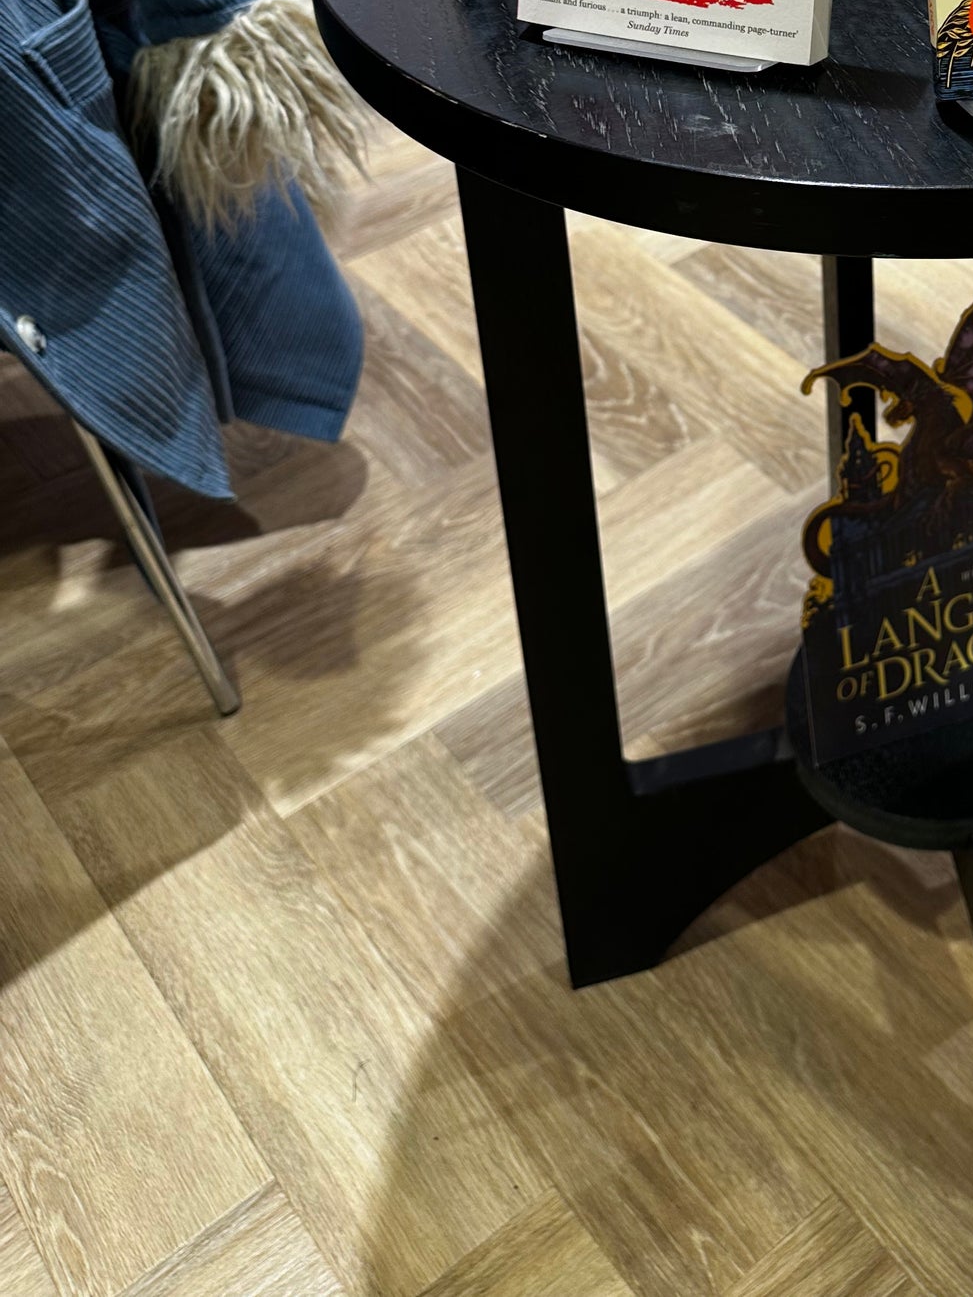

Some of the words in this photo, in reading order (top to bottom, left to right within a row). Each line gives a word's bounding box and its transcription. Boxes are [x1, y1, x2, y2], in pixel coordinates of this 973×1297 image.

[579, 0, 606, 12] furious
[627, 7, 662, 20] triumph:
[671, 12, 691, 24] lean,
[691, 17, 746, 33] commanding
[747, 24, 799, 39] page-turner’
[627, 20, 662, 35] Sunday
[663, 25, 690, 38] Times
[916, 566, 943, 603] A
[836, 671, 874, 702] OF
[854, 713, 878, 735] S.
[884, 705, 904, 725] F.
